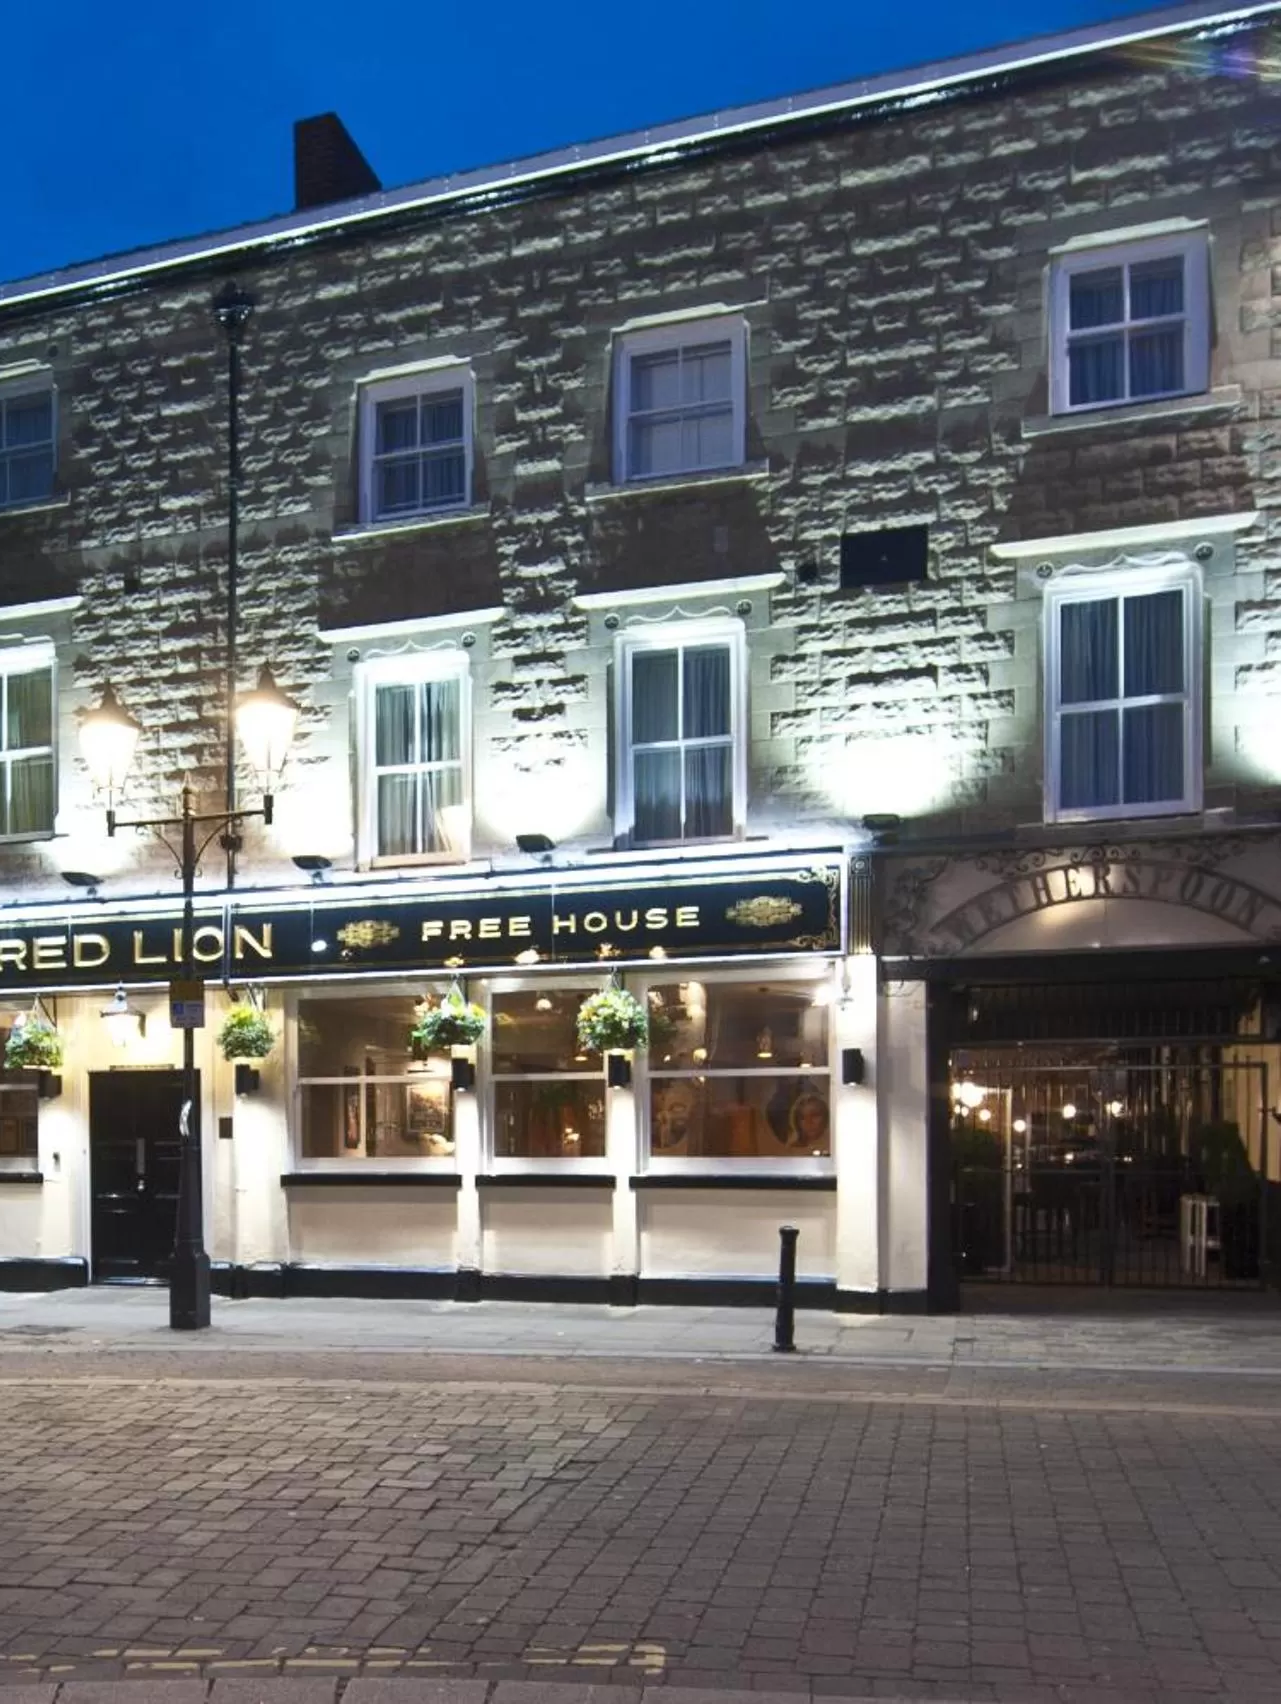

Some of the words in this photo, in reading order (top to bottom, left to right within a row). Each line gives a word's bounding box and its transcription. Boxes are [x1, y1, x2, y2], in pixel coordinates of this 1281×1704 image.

[948, 860, 1266, 944] WETHERSPOON
[133, 922, 273, 964] LION
[421, 915, 532, 942] FREE
[552, 905, 700, 935] HOUSE
